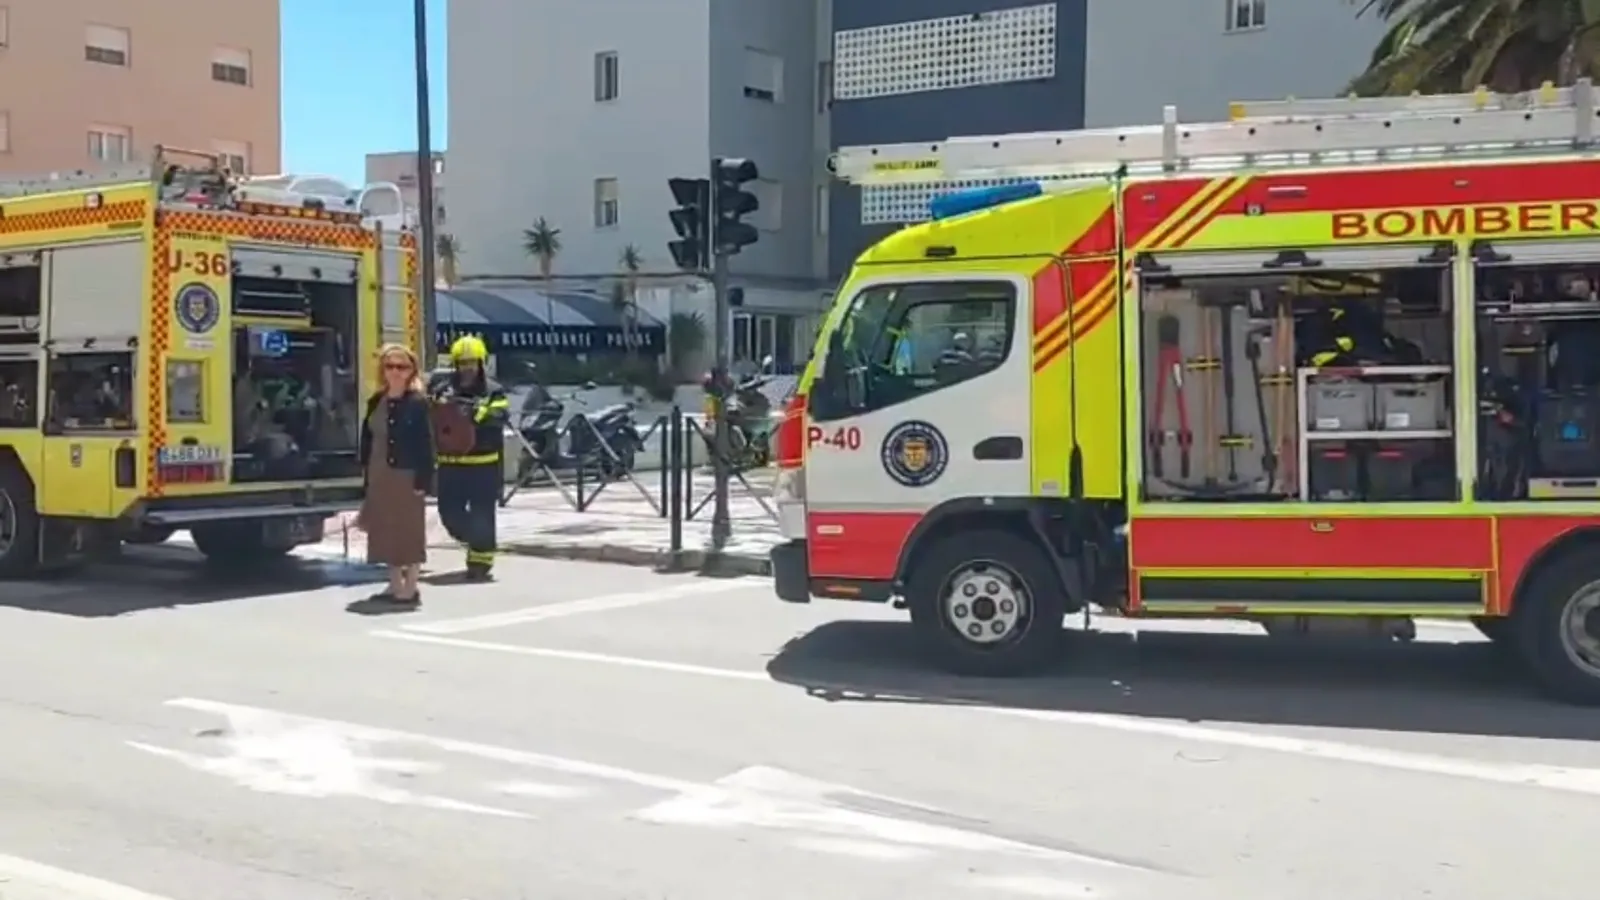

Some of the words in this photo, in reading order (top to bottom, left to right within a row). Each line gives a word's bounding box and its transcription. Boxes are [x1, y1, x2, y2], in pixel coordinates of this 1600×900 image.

[1332, 203, 1600, 239] BOMBER
[164, 247, 227, 277] U-36
[502, 331, 591, 347] RESTAURANTE
[807, 427, 861, 450] P-40
